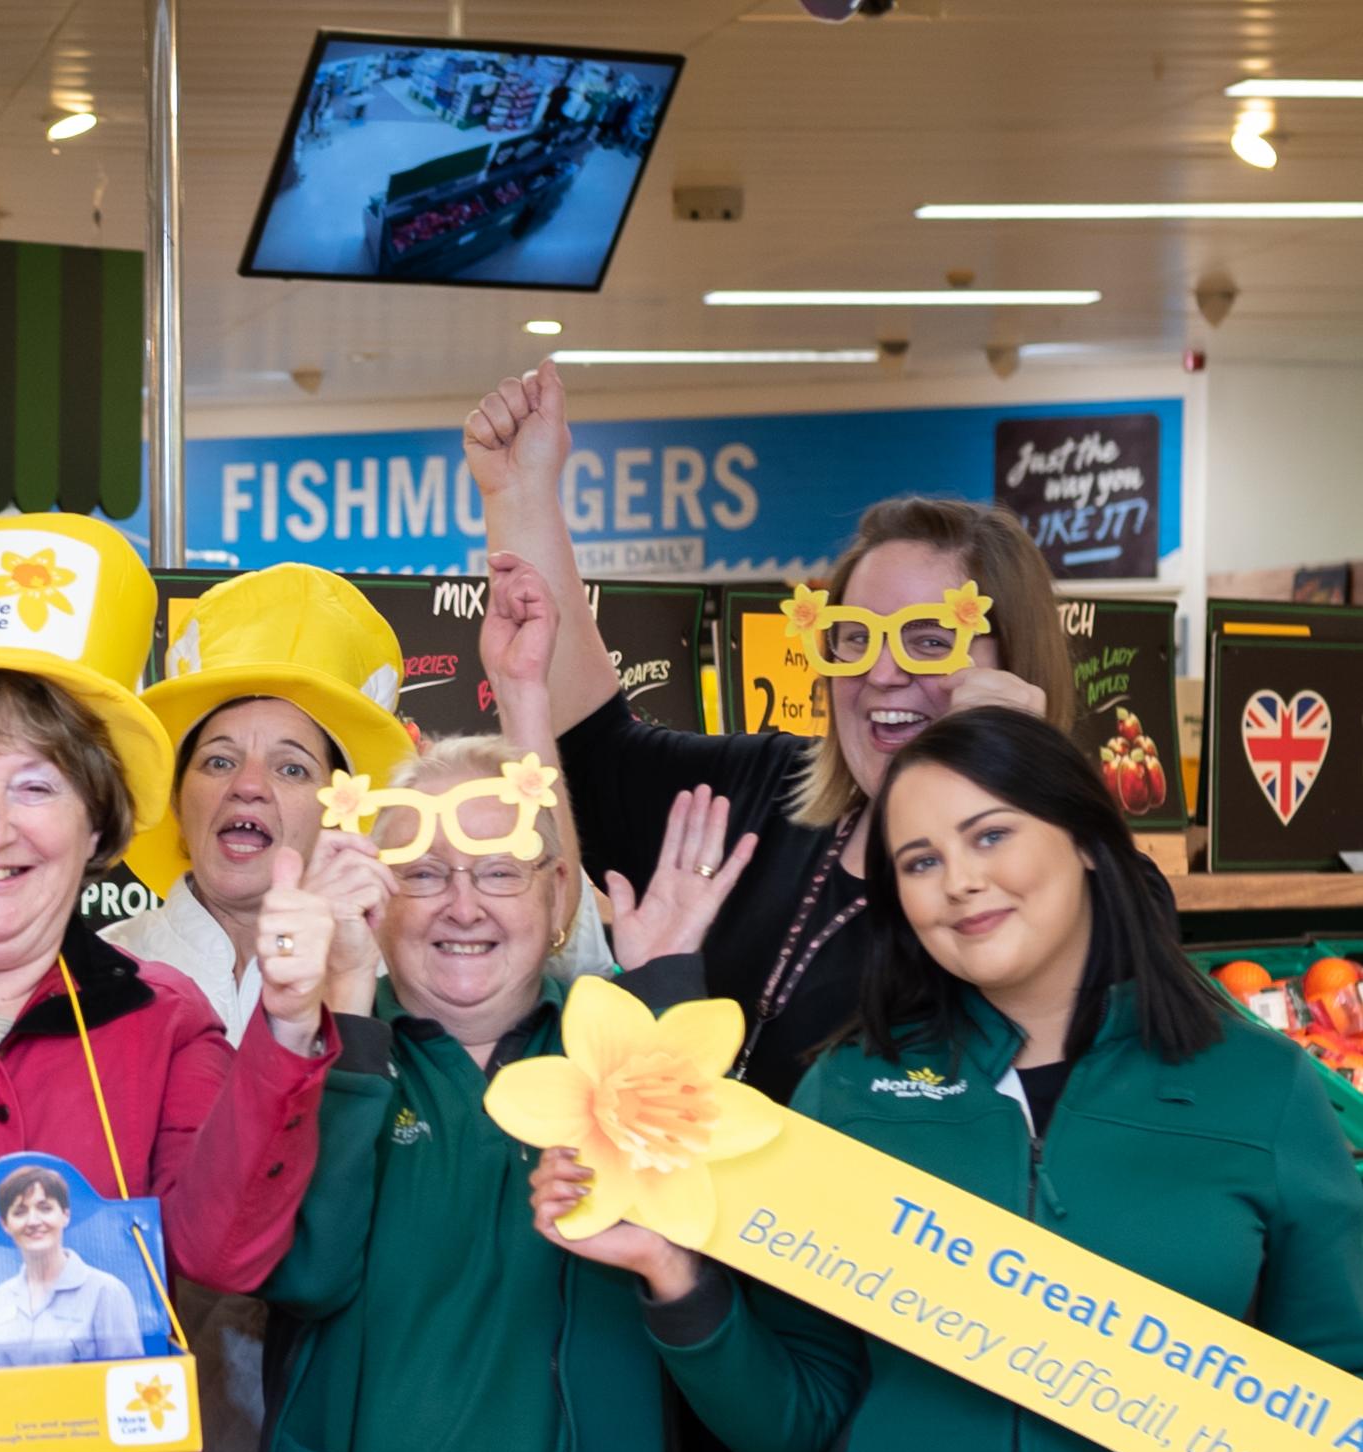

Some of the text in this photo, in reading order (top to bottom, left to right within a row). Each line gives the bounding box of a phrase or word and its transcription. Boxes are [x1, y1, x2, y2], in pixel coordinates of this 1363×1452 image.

[433, 581, 488, 619] MIX
[781, 695, 805, 719] for
[738, 1207, 895, 1301] Behind
[890, 1287, 1008, 1361] every
[1006, 1340, 1180, 1449] daffodil,
[890, 1196, 975, 1268] The
[987, 1247, 1122, 1338] Great
[1129, 1313, 1331, 1438] Daffodil
